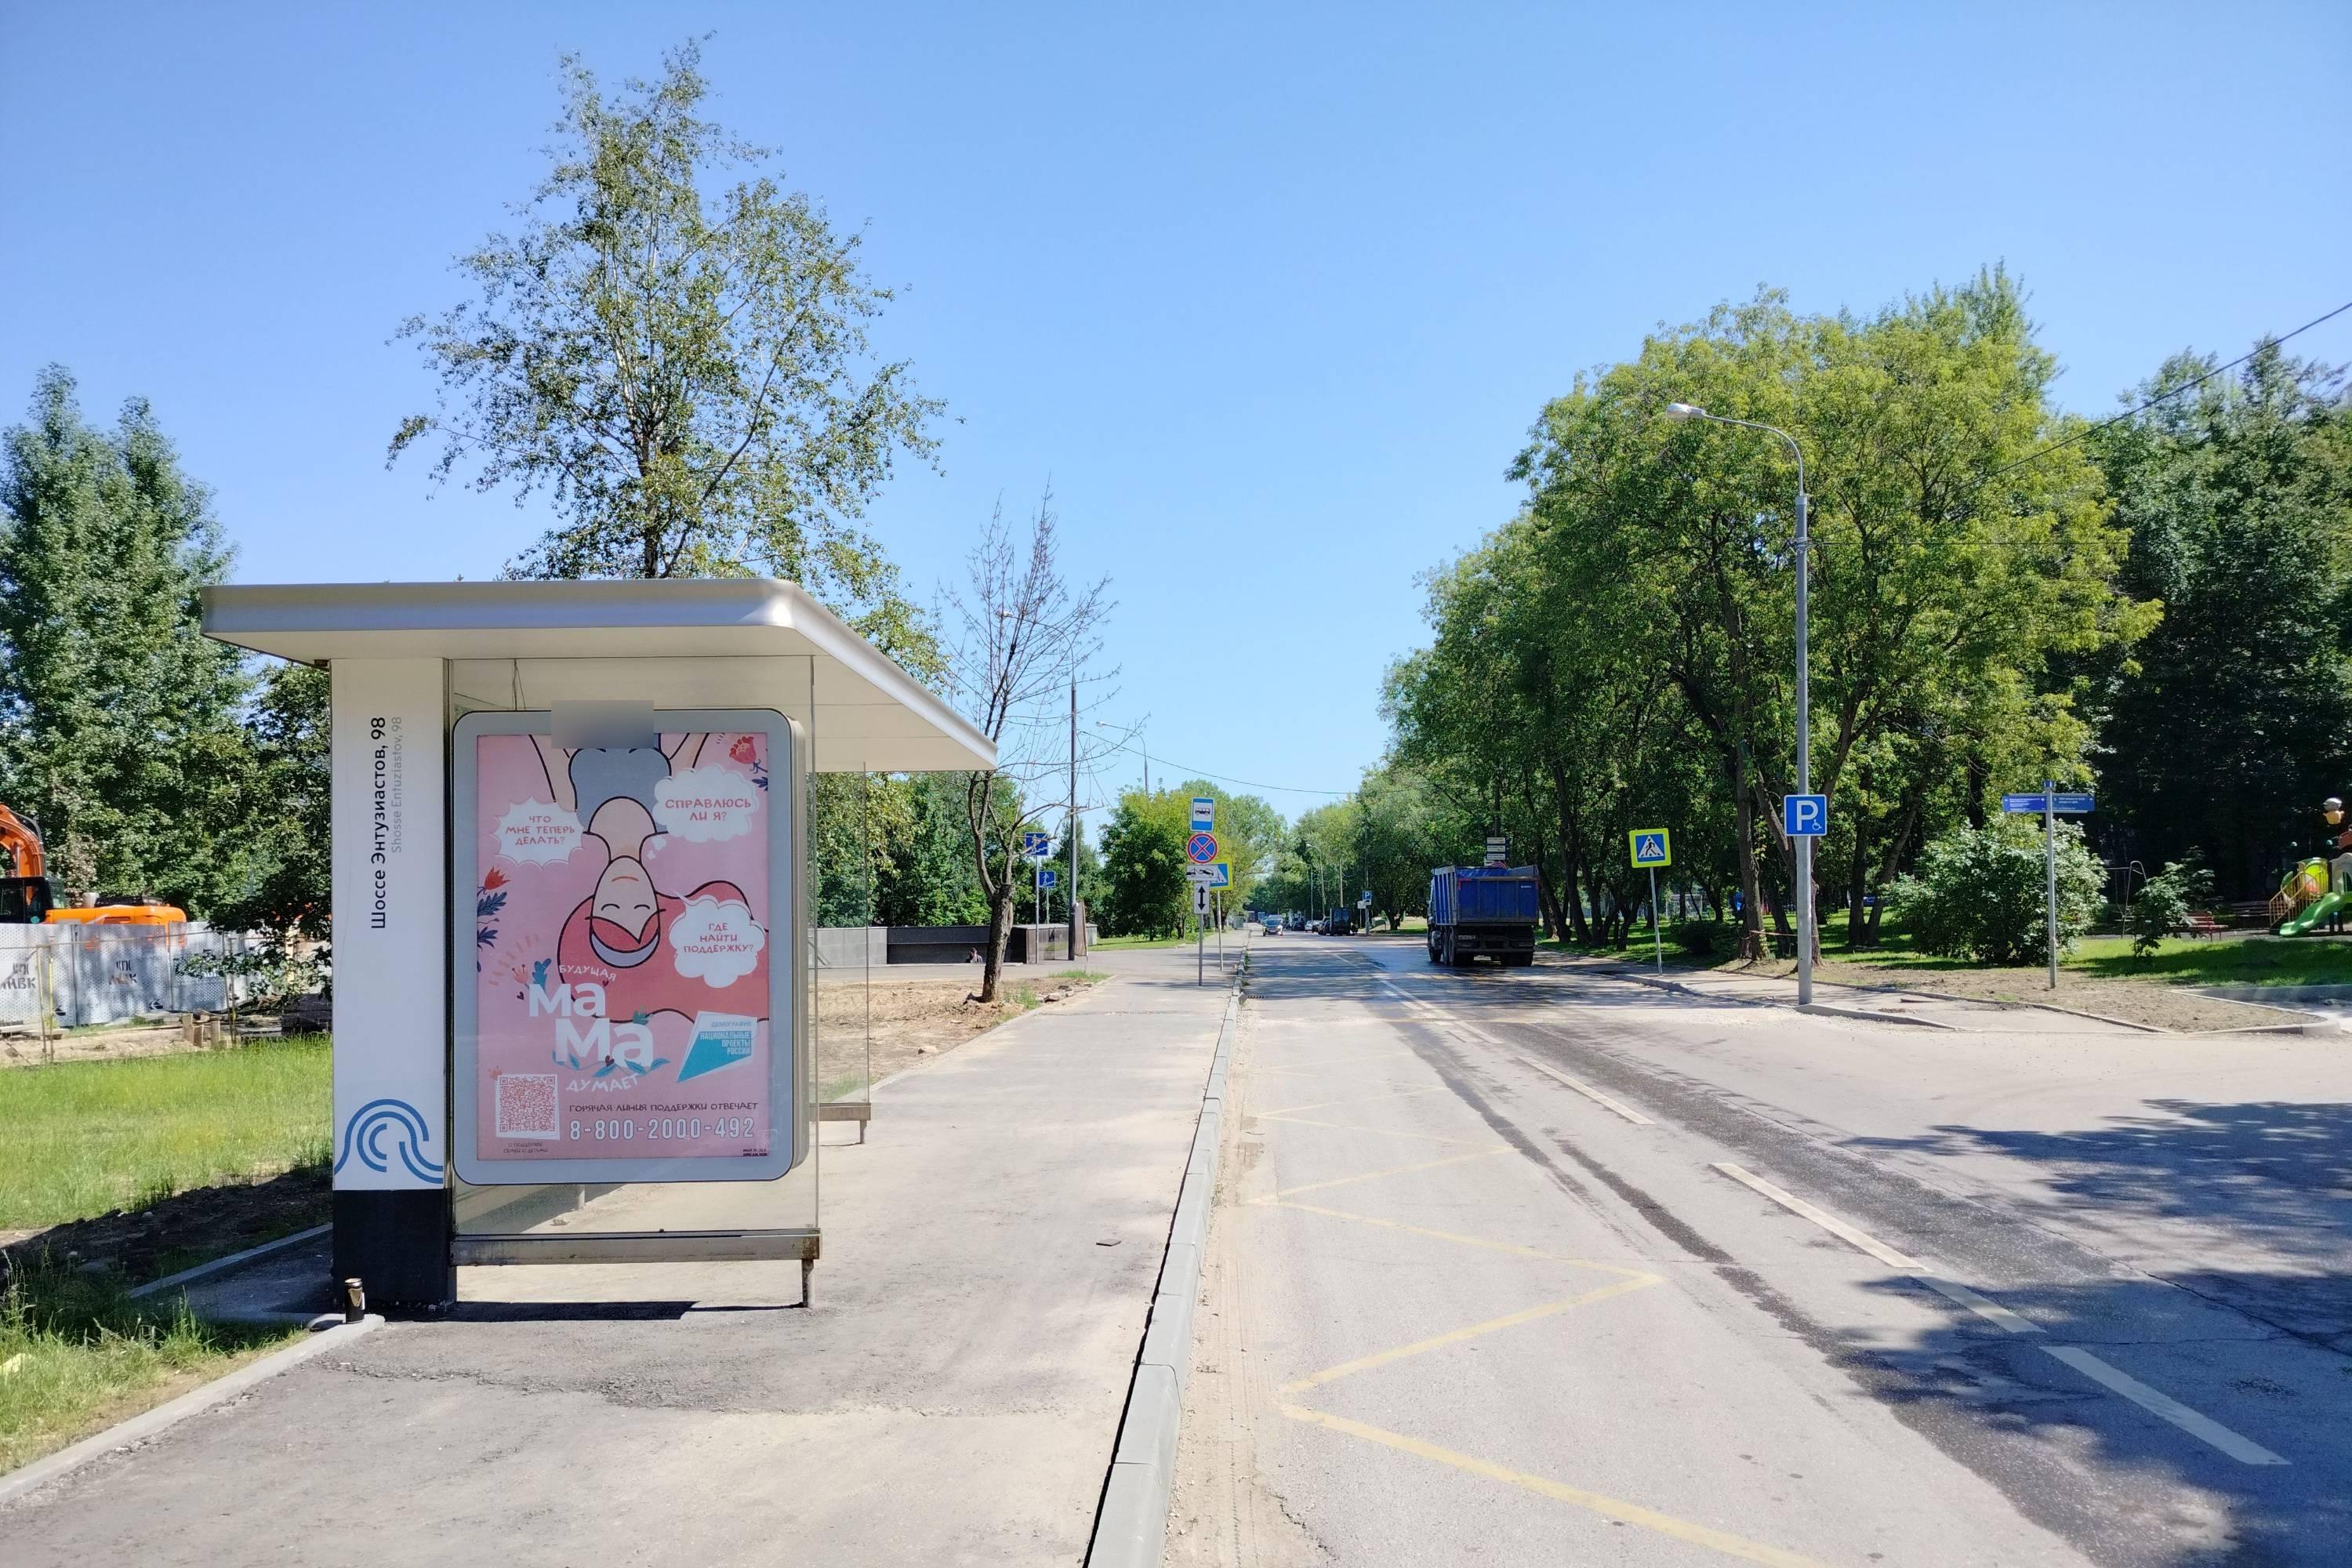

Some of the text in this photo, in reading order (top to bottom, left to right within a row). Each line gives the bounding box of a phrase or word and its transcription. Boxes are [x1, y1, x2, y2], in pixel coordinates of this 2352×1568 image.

[391, 717, 403, 853] Shosse Entuziastov, 98
[665, 798, 751, 809] СПРАВЛЮСЬ
[690, 811, 728, 821] ЛИ Я?
[371, 717, 389, 929] Шоссе Энтузиастов, 98
[505, 826, 575, 834] МНЕ ТЕПЕРЬ
[514, 836, 565, 846] ДЕЛАТЬ?
[708, 922, 728, 932] ГДЕ
[699, 932, 738, 942] НАЙТИ
[684, 944, 754, 954] ПОДДЕРЖКУ?
[559, 964, 616, 982] БУДУЩАЯ
[699, 1032, 750, 1040] НАЦИОНАЛЬНЫЕ
[566, 1073, 640, 1093] ДУМАЕТ
[569, 1102, 758, 1112] ГОРЯЧАЯ ЛИНИЯ ПОДДЕРЖКИ ОТВЕЧАЕТ
[569, 1116, 754, 1141] 8-800-2000-492
